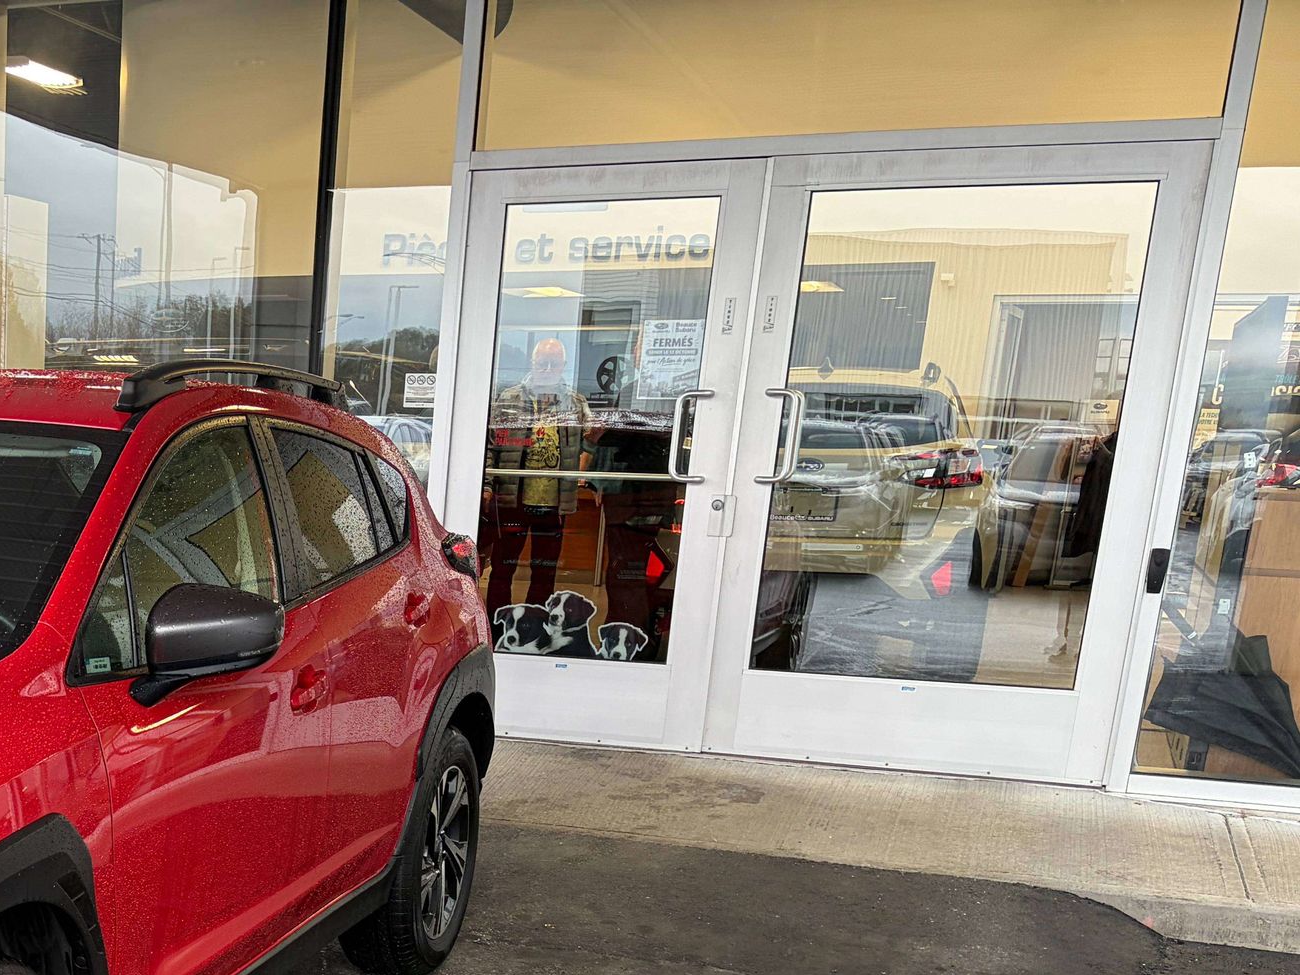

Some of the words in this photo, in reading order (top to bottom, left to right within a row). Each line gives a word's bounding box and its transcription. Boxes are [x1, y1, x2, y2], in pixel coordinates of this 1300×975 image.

[515, 233, 555, 265] et
[568, 226, 712, 264] service
[653, 335, 694, 348] FERMÉS
